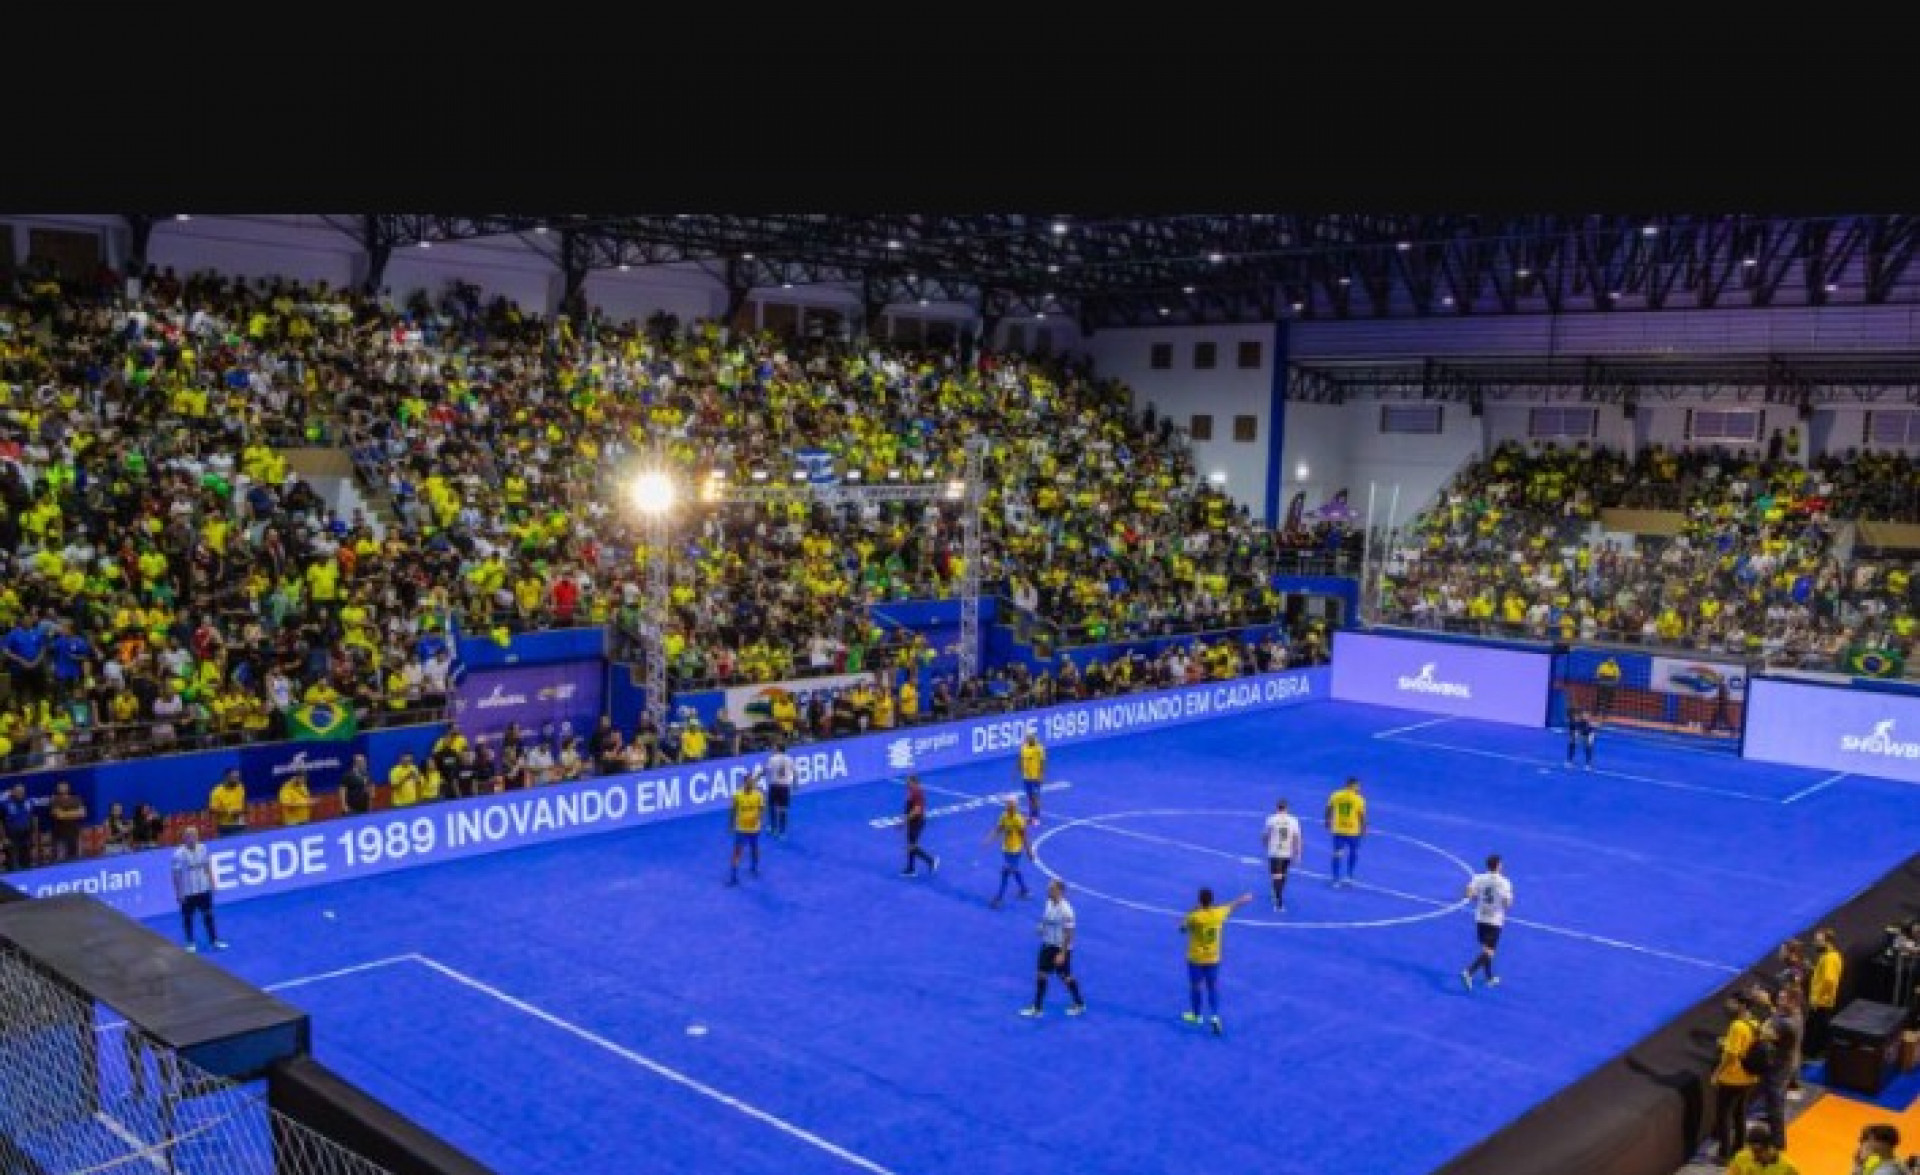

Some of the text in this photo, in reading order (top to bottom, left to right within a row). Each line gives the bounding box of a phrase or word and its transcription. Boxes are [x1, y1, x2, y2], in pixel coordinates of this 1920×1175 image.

[971, 675, 1310, 753] DESDE 1989 INOVANDO EM CADA OBRA
[211, 833, 328, 889] ESDE
[336, 816, 436, 868] 1989
[446, 786, 628, 848] INOVANDO
[636, 775, 680, 814] EM
[793, 749, 848, 785] BRA
